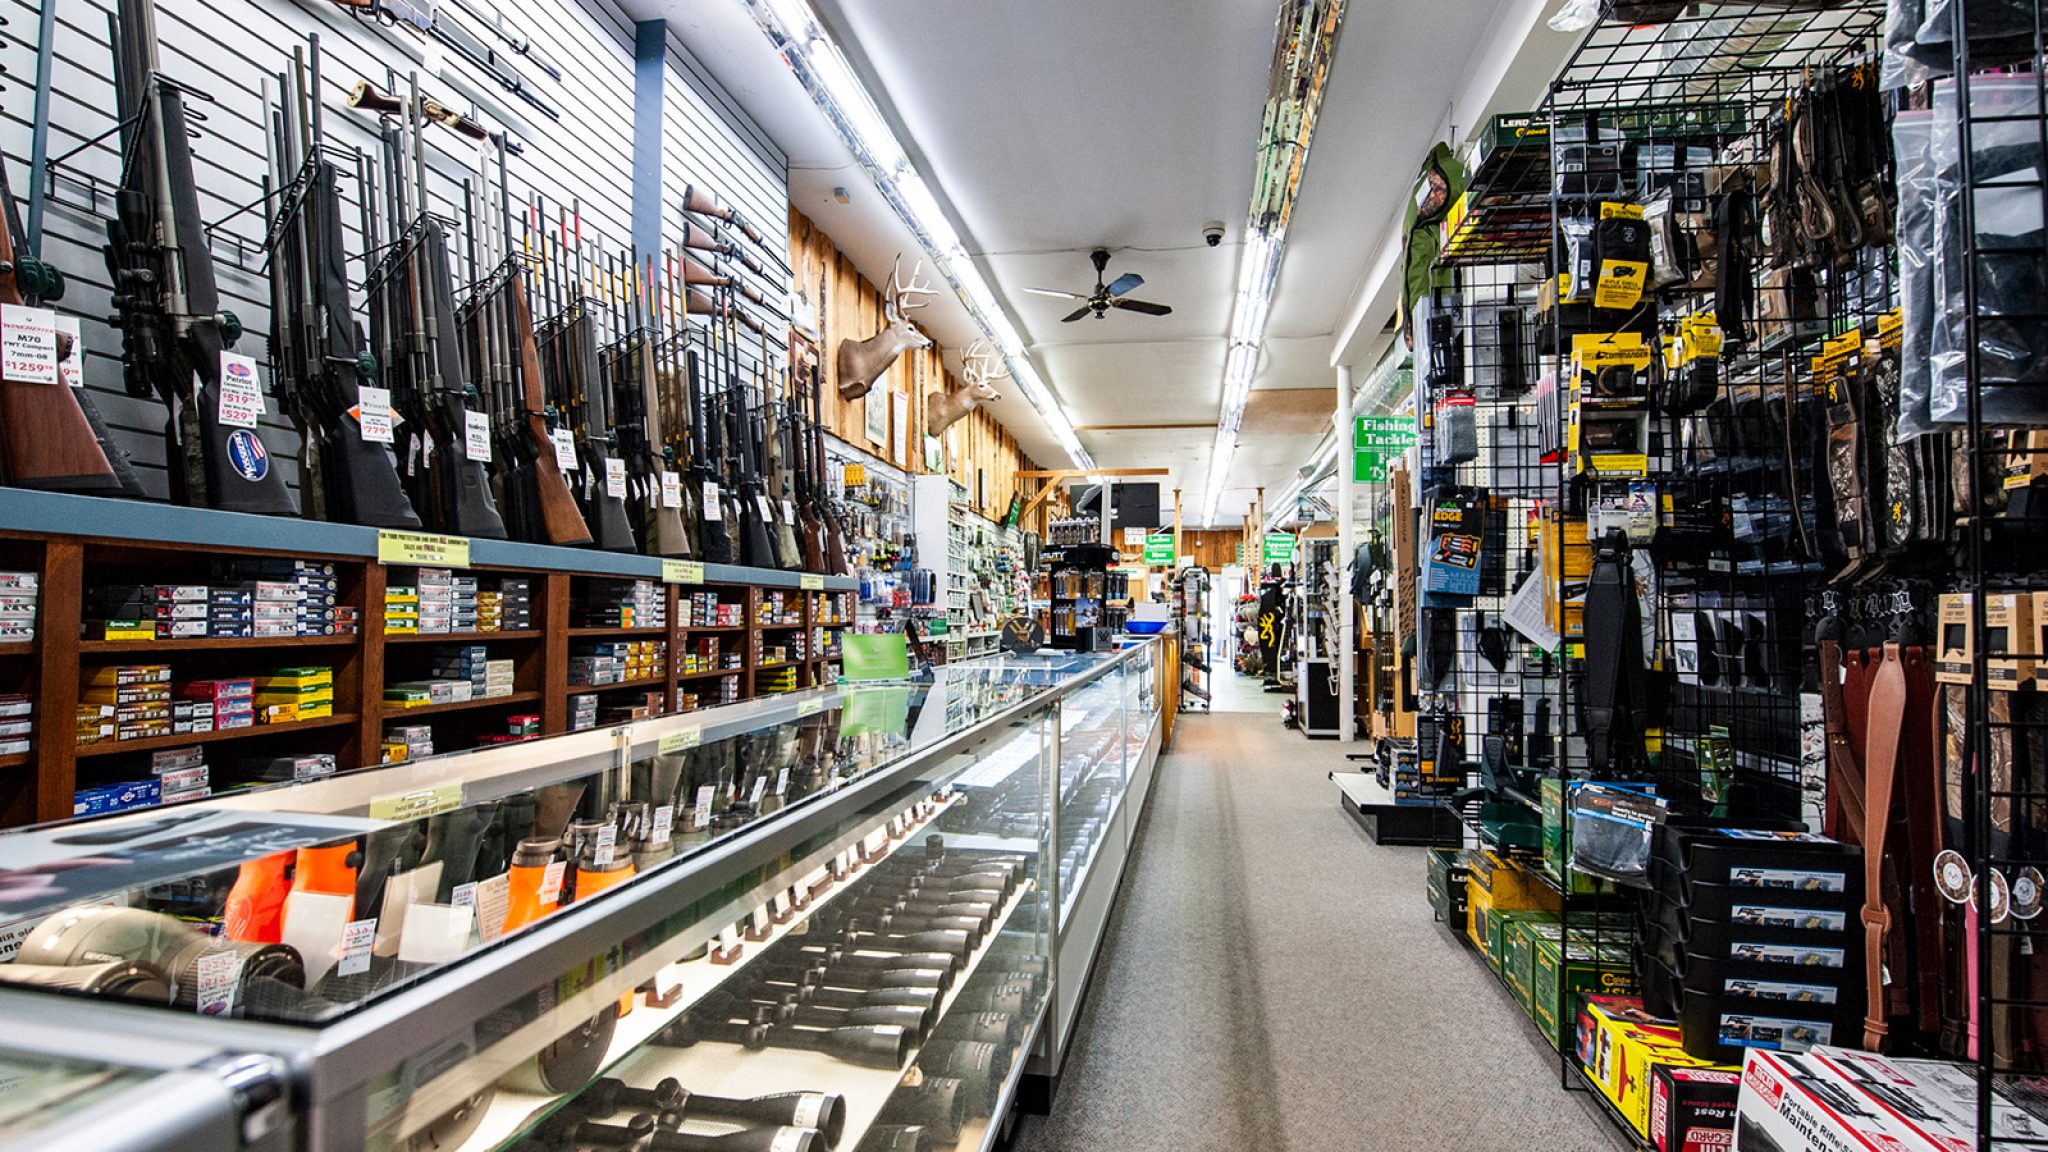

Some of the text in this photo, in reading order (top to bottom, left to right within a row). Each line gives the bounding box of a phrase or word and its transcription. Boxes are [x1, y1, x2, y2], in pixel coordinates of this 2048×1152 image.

[17, 333, 41, 344] M70
[22, 342, 54, 352] Compact
[5, 359, 44, 372] $1259
[226, 374, 252, 385] Patriot
[223, 392, 248, 404] $519
[222, 408, 248, 420] $529
[1363, 419, 1415, 434] Fishing
[1434, 511, 1463, 522] EDGE
[424, 544, 435, 552] FINAL
[1694, 1107, 1726, 1118] Rest
[1783, 1092, 1819, 1128] Portable
[1779, 1102, 1834, 1152] Mainten
[1690, 1131, 1732, 1142] E-GARD
